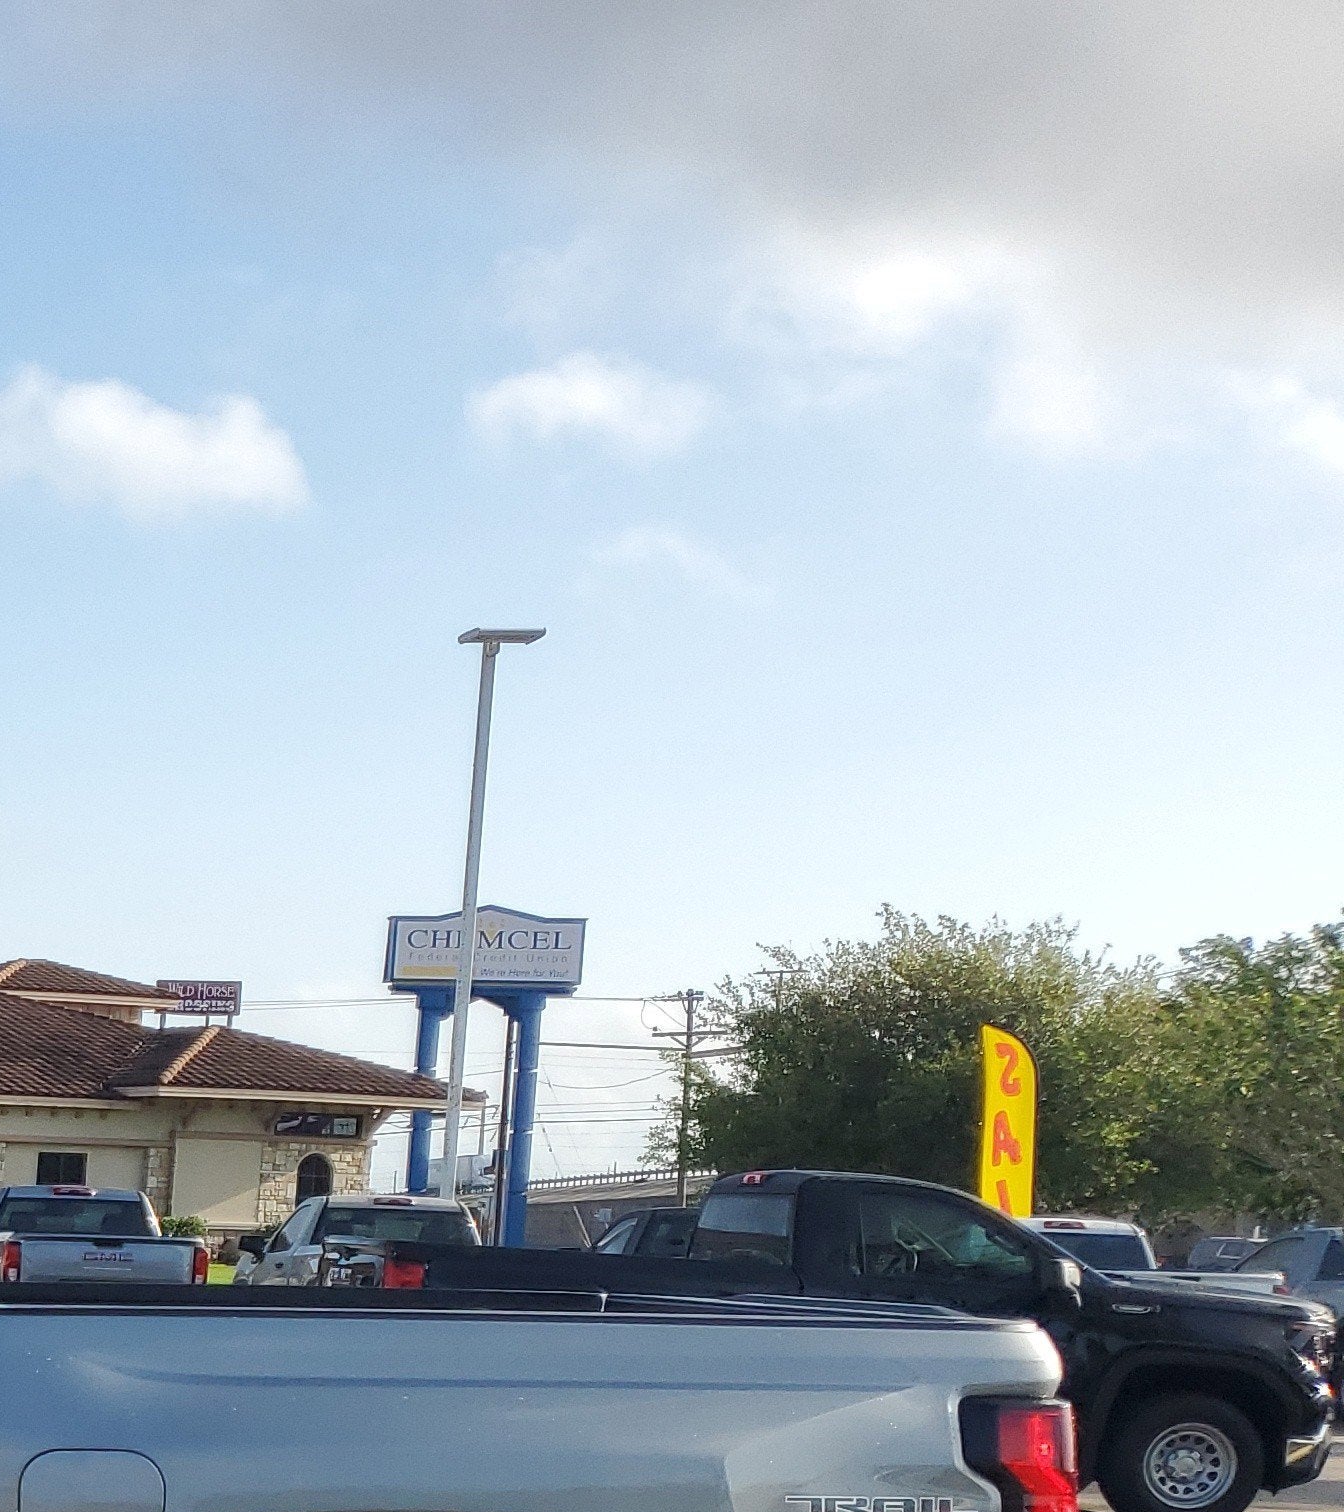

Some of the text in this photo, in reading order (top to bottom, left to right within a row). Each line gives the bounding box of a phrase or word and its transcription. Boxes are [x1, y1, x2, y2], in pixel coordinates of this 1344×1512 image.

[407, 928, 572, 950] CHMCEL
[409, 952, 461, 961] Federa
[526, 953, 568, 963] Union
